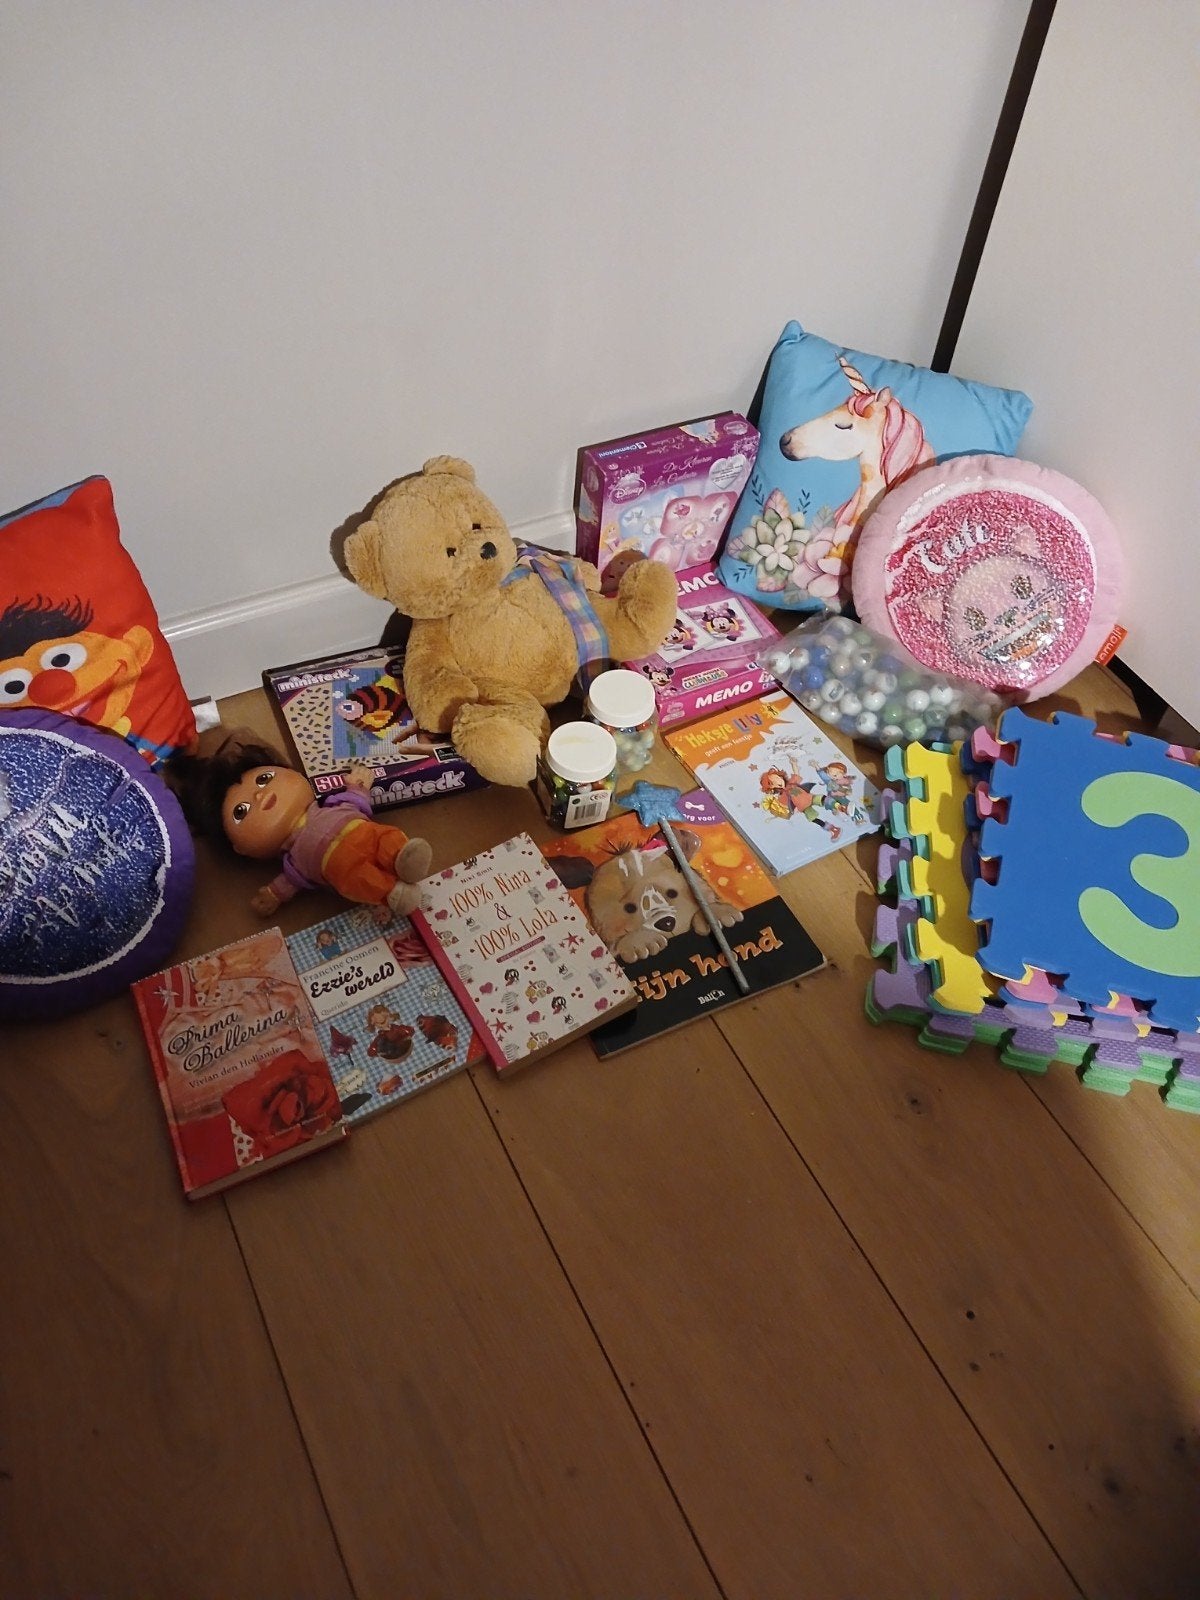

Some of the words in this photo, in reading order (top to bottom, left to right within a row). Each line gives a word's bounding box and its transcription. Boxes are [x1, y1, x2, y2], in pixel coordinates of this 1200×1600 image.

[615, 487, 644, 499] Disney
[677, 572, 720, 596] MO
[278, 669, 353, 692] ministeck
[695, 680, 753, 708] MEMO
[685, 723, 733, 748] Heksje
[371, 770, 465, 805] inisteck
[1079, 772, 1200, 977] 3
[449, 883, 494, 917] 100%
[493, 869, 531, 896] Nina
[494, 902, 512, 920] &
[474, 923, 520, 960] 100%
[519, 907, 558, 938] Lola
[303, 958, 345, 983] Francine
[345, 945, 379, 965] Oomen
[344, 961, 395, 997] wereld
[310, 966, 364, 998] Ezzie's
[631, 968, 692, 1002] ijn
[168, 1012, 238, 1055] Prima
[184, 1008, 288, 1072] Ballerina
[189, 1073, 218, 1088] Vivian
[221, 1065, 238, 1077] den
[240, 1046, 284, 1068] Hollander
